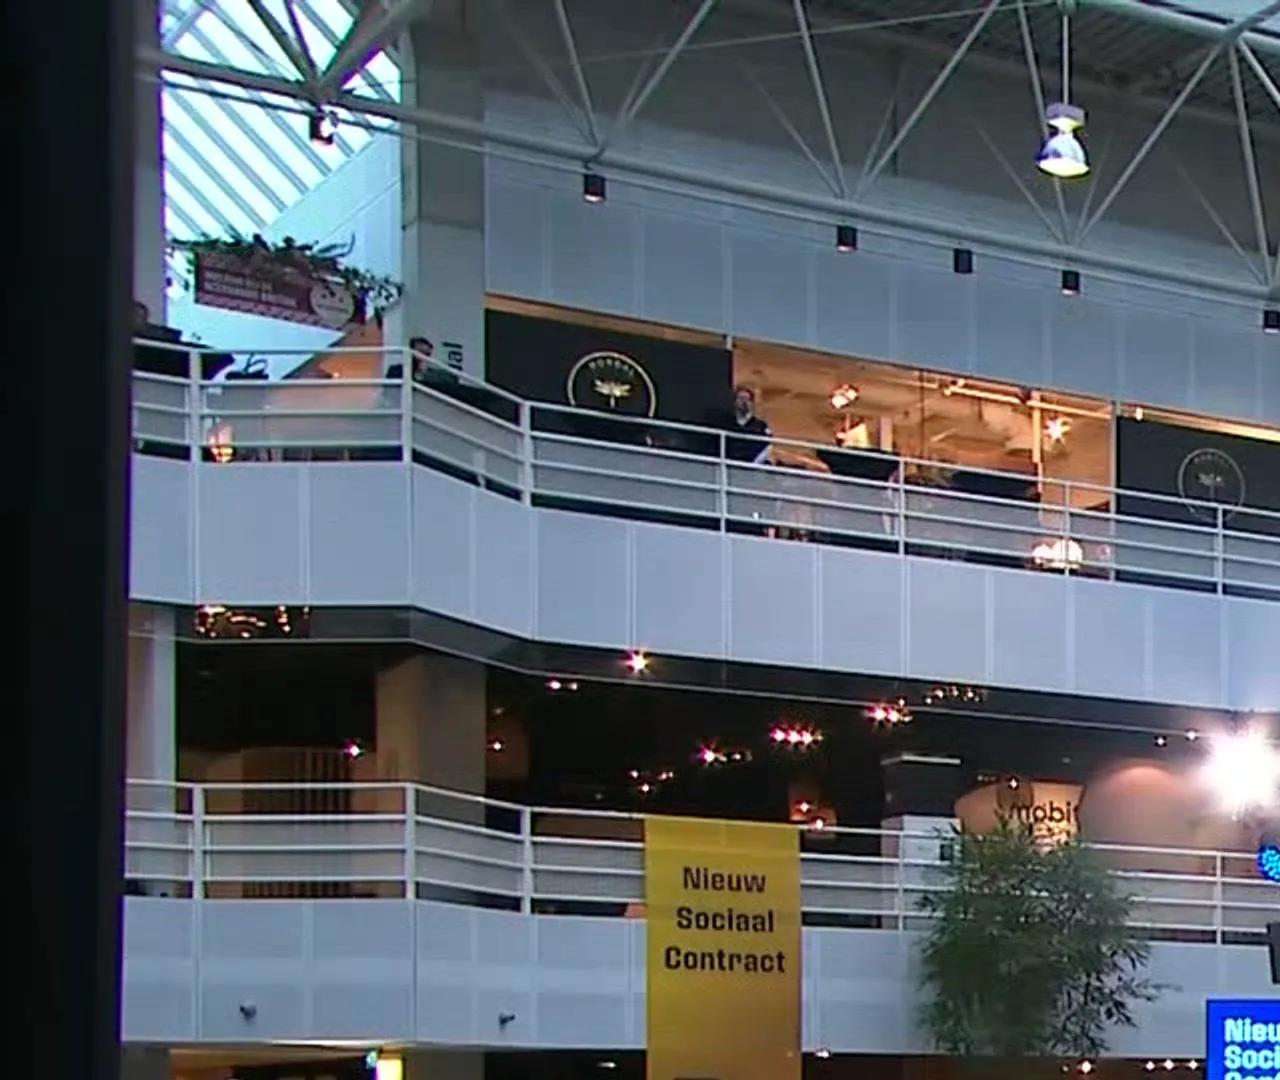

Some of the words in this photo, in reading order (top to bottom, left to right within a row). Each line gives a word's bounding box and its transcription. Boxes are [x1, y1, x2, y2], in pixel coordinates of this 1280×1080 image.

[683, 866, 767, 893] Nieuw
[676, 907, 775, 934] Sociaal
[664, 946, 786, 974] Contract
